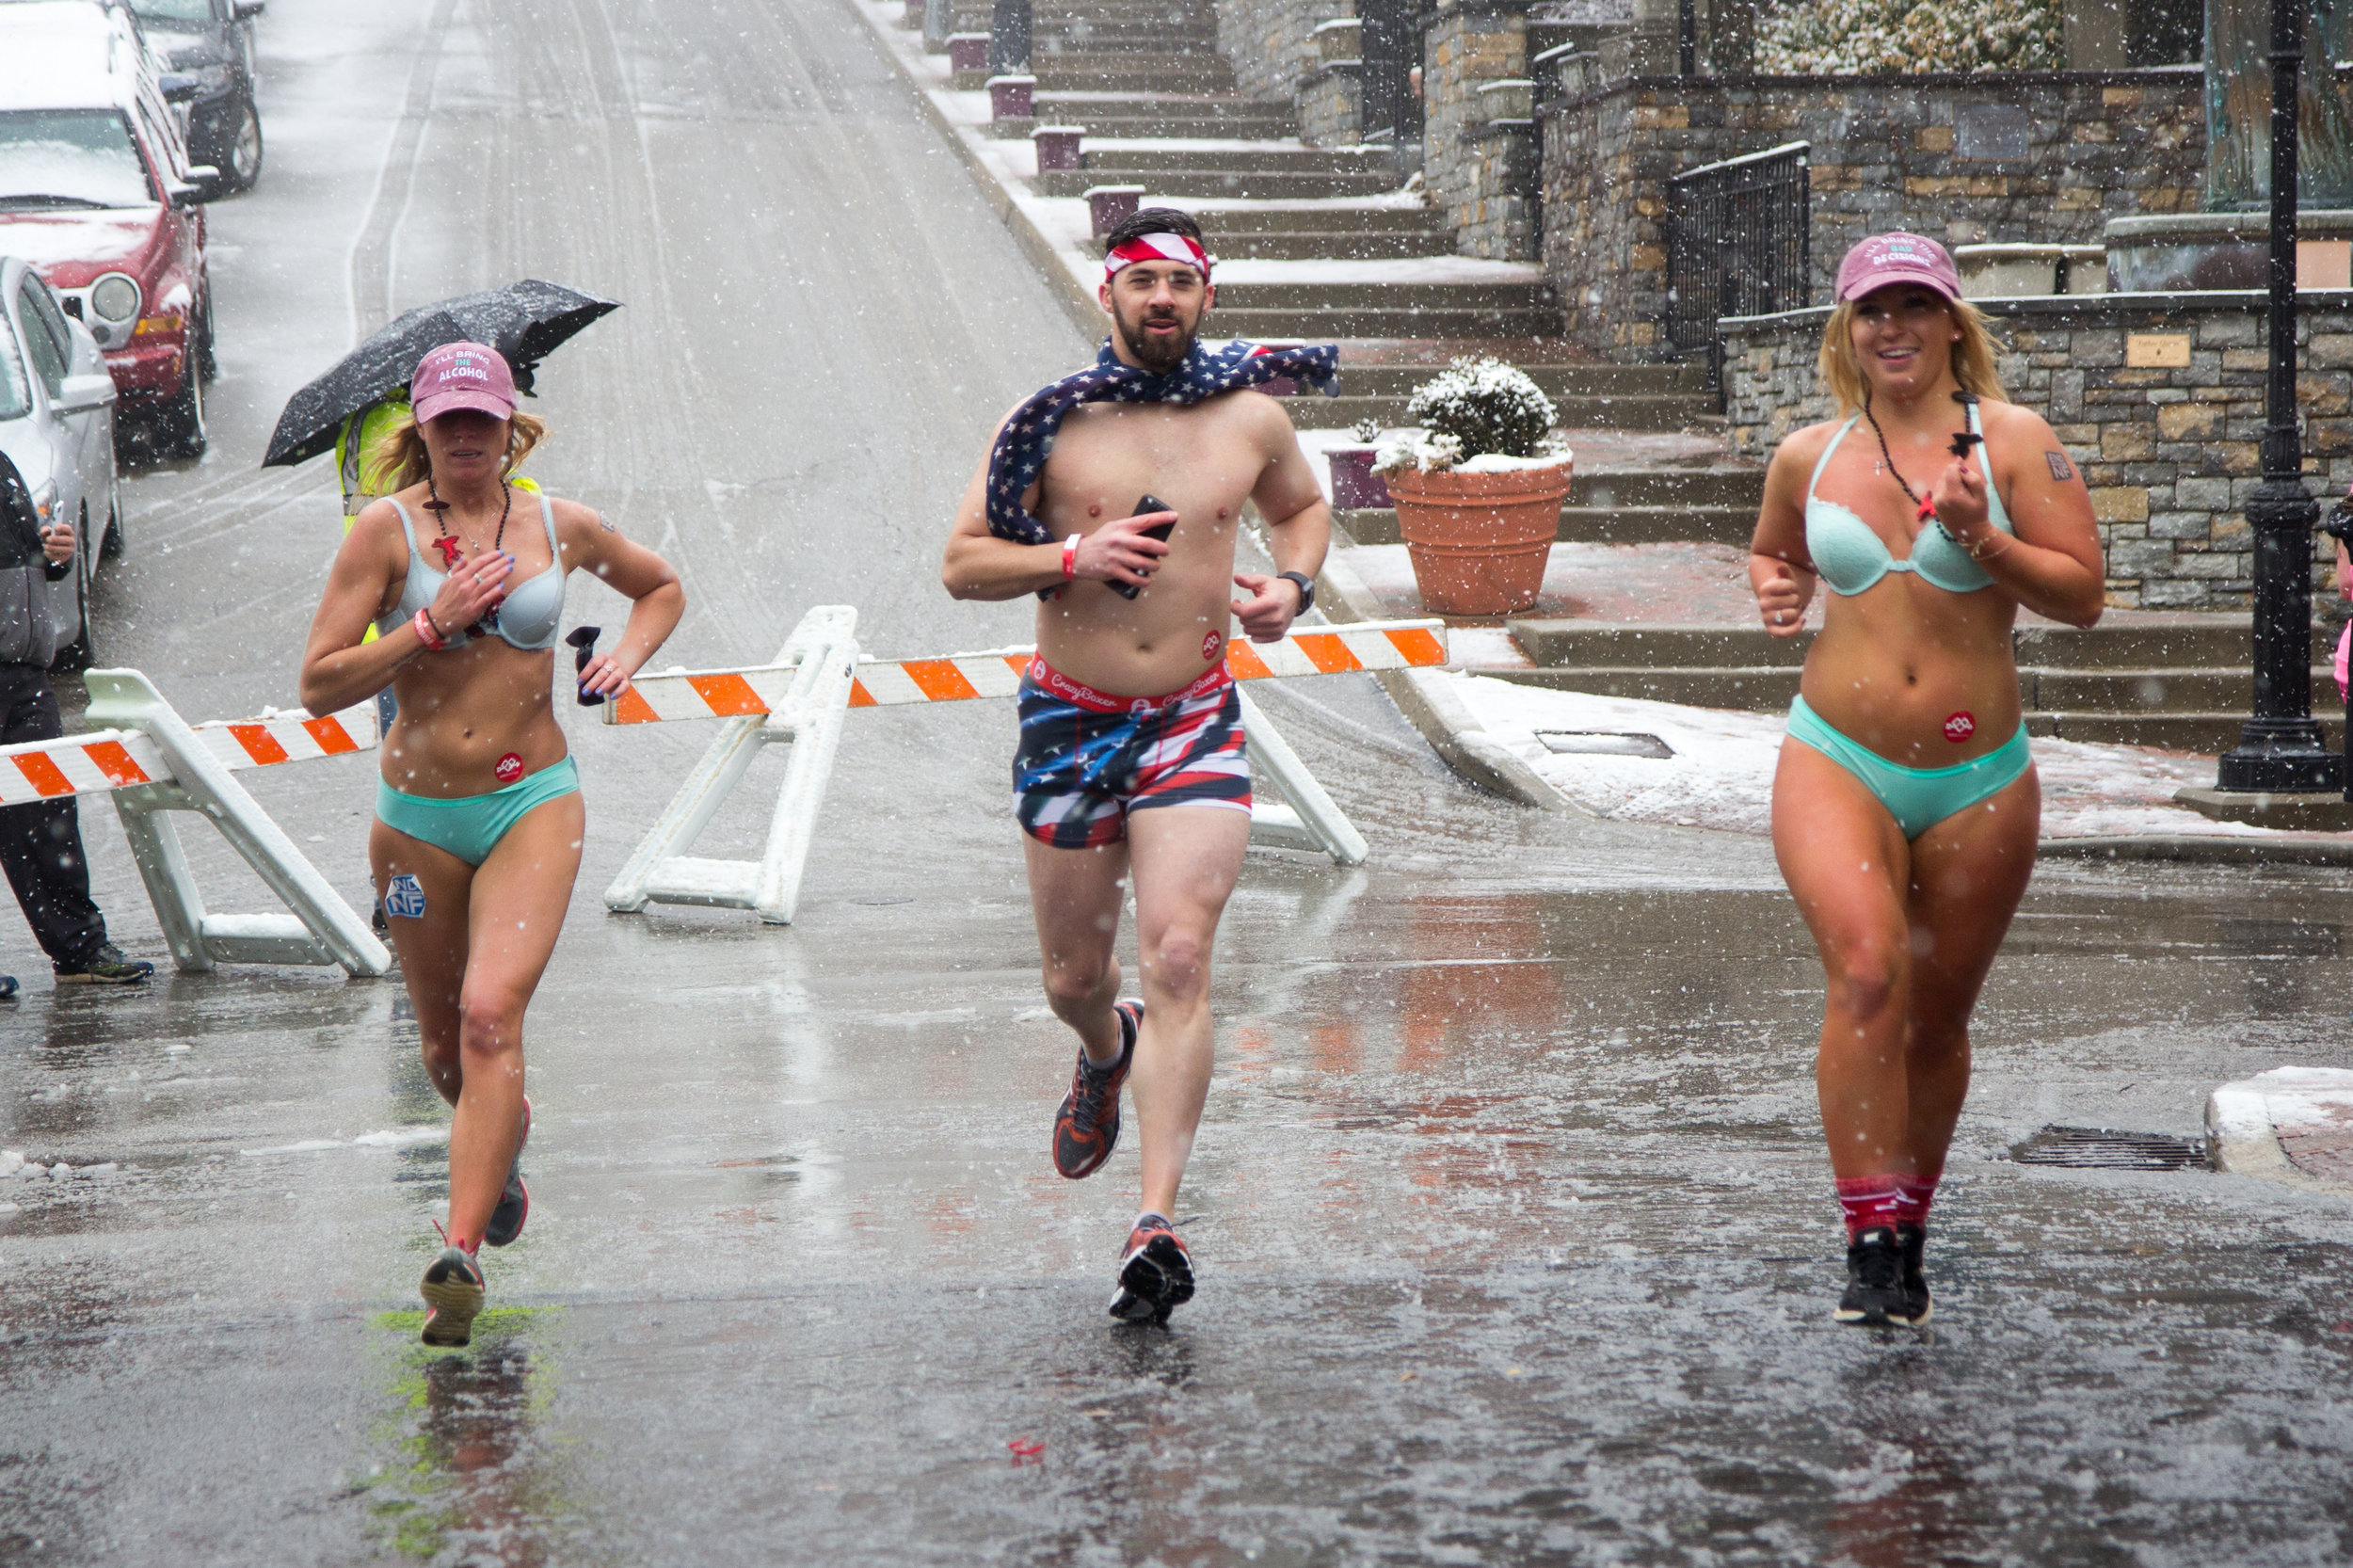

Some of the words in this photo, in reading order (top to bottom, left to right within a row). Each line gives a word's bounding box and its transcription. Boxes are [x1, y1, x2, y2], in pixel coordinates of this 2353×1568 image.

[1880, 236, 1917, 245] BRING
[1873, 252, 1932, 267] DECISIONS
[435, 354, 453, 364] I'LL
[456, 350, 489, 364] BRING
[439, 367, 488, 382] ALCOHOL
[1051, 673, 1118, 707] CrazyBoxer
[389, 895, 424, 914] NF
